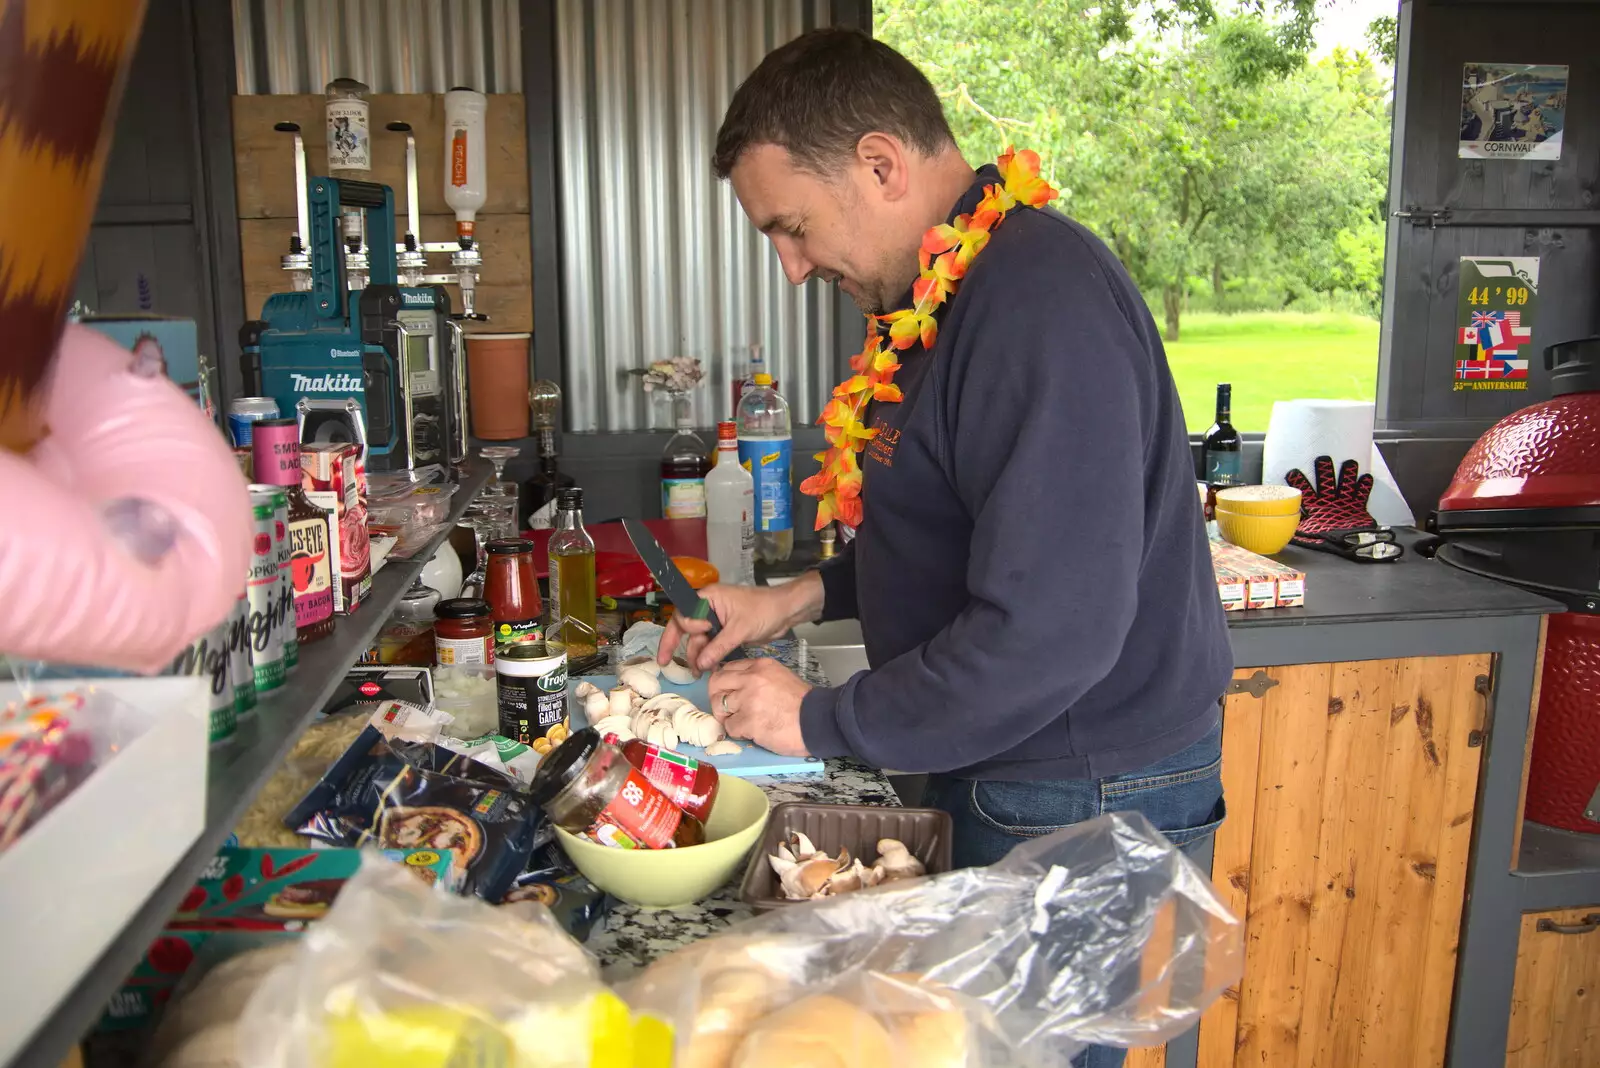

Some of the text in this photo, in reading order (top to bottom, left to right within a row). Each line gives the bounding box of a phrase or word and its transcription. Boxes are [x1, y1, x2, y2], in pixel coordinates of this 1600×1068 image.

[455, 145, 464, 180] PEACH
[308, 594, 331, 610] BACON
[539, 709, 562, 724] GARLIC
